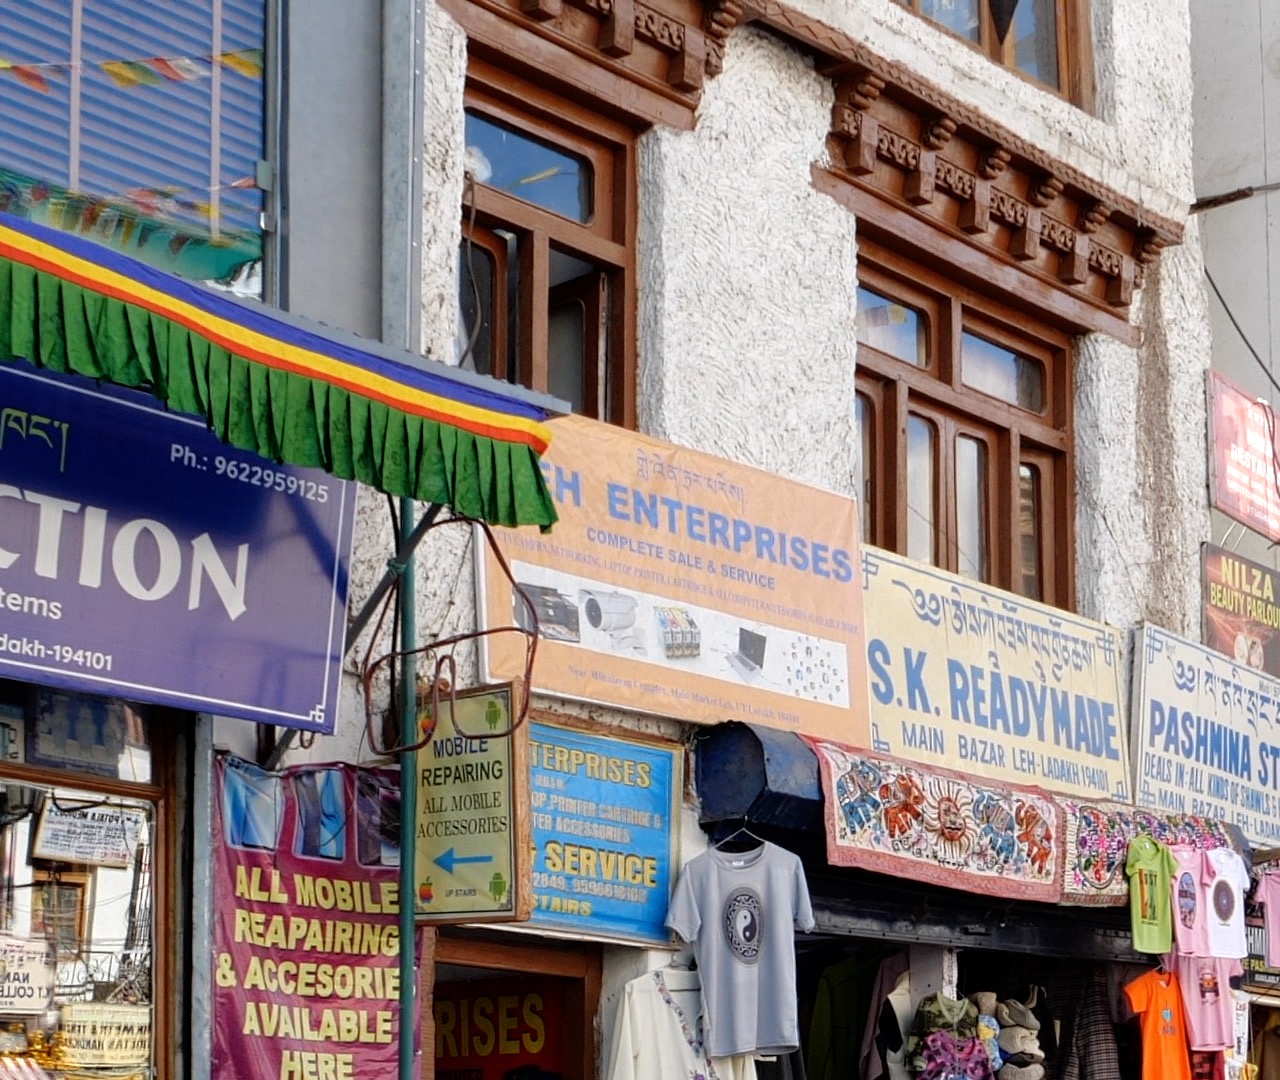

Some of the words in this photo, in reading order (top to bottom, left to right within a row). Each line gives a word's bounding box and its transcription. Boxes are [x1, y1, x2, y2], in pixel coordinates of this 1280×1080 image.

[215, 454, 329, 504] 9622959125
[607, 480, 852, 584] ENTERPRISES
[587, 527, 663, 559] COMPLETE
[669, 549, 703, 570] SALE
[707, 560, 716, 574] &
[720, 564, 776, 590] SERVICE
[1220, 556, 1275, 601] NILZA
[1210, 583, 1246, 618] BEAUTY
[867, 638, 941, 717] S.K.
[947, 658, 1120, 762] READYMADE
[433, 736, 488, 759] MOBILE
[902, 721, 945, 754] MAIN
[959, 737, 1005, 769] BAZAR
[1148, 698, 1252, 784] PASHMINA
[422, 760, 503, 787] REPAIRING
[1144, 752, 1172, 785] DEALS
[1188, 766, 1204, 795] ALL
[423, 796, 447, 815] ALL
[451, 791, 501, 812] MOBILE
[1158, 788, 1185, 812] MAIN
[417, 816, 507, 838] ACCESSORIES
[545, 840, 659, 888] SERVICE
[235, 865, 289, 906] ALL
[294, 874, 400, 916] MOBILE
[234, 909, 400, 958] REAPAIRING
[216, 953, 236, 988] &
[244, 957, 417, 1000] ACCESORIE
[242, 1002, 393, 1044] AVAILABLE
